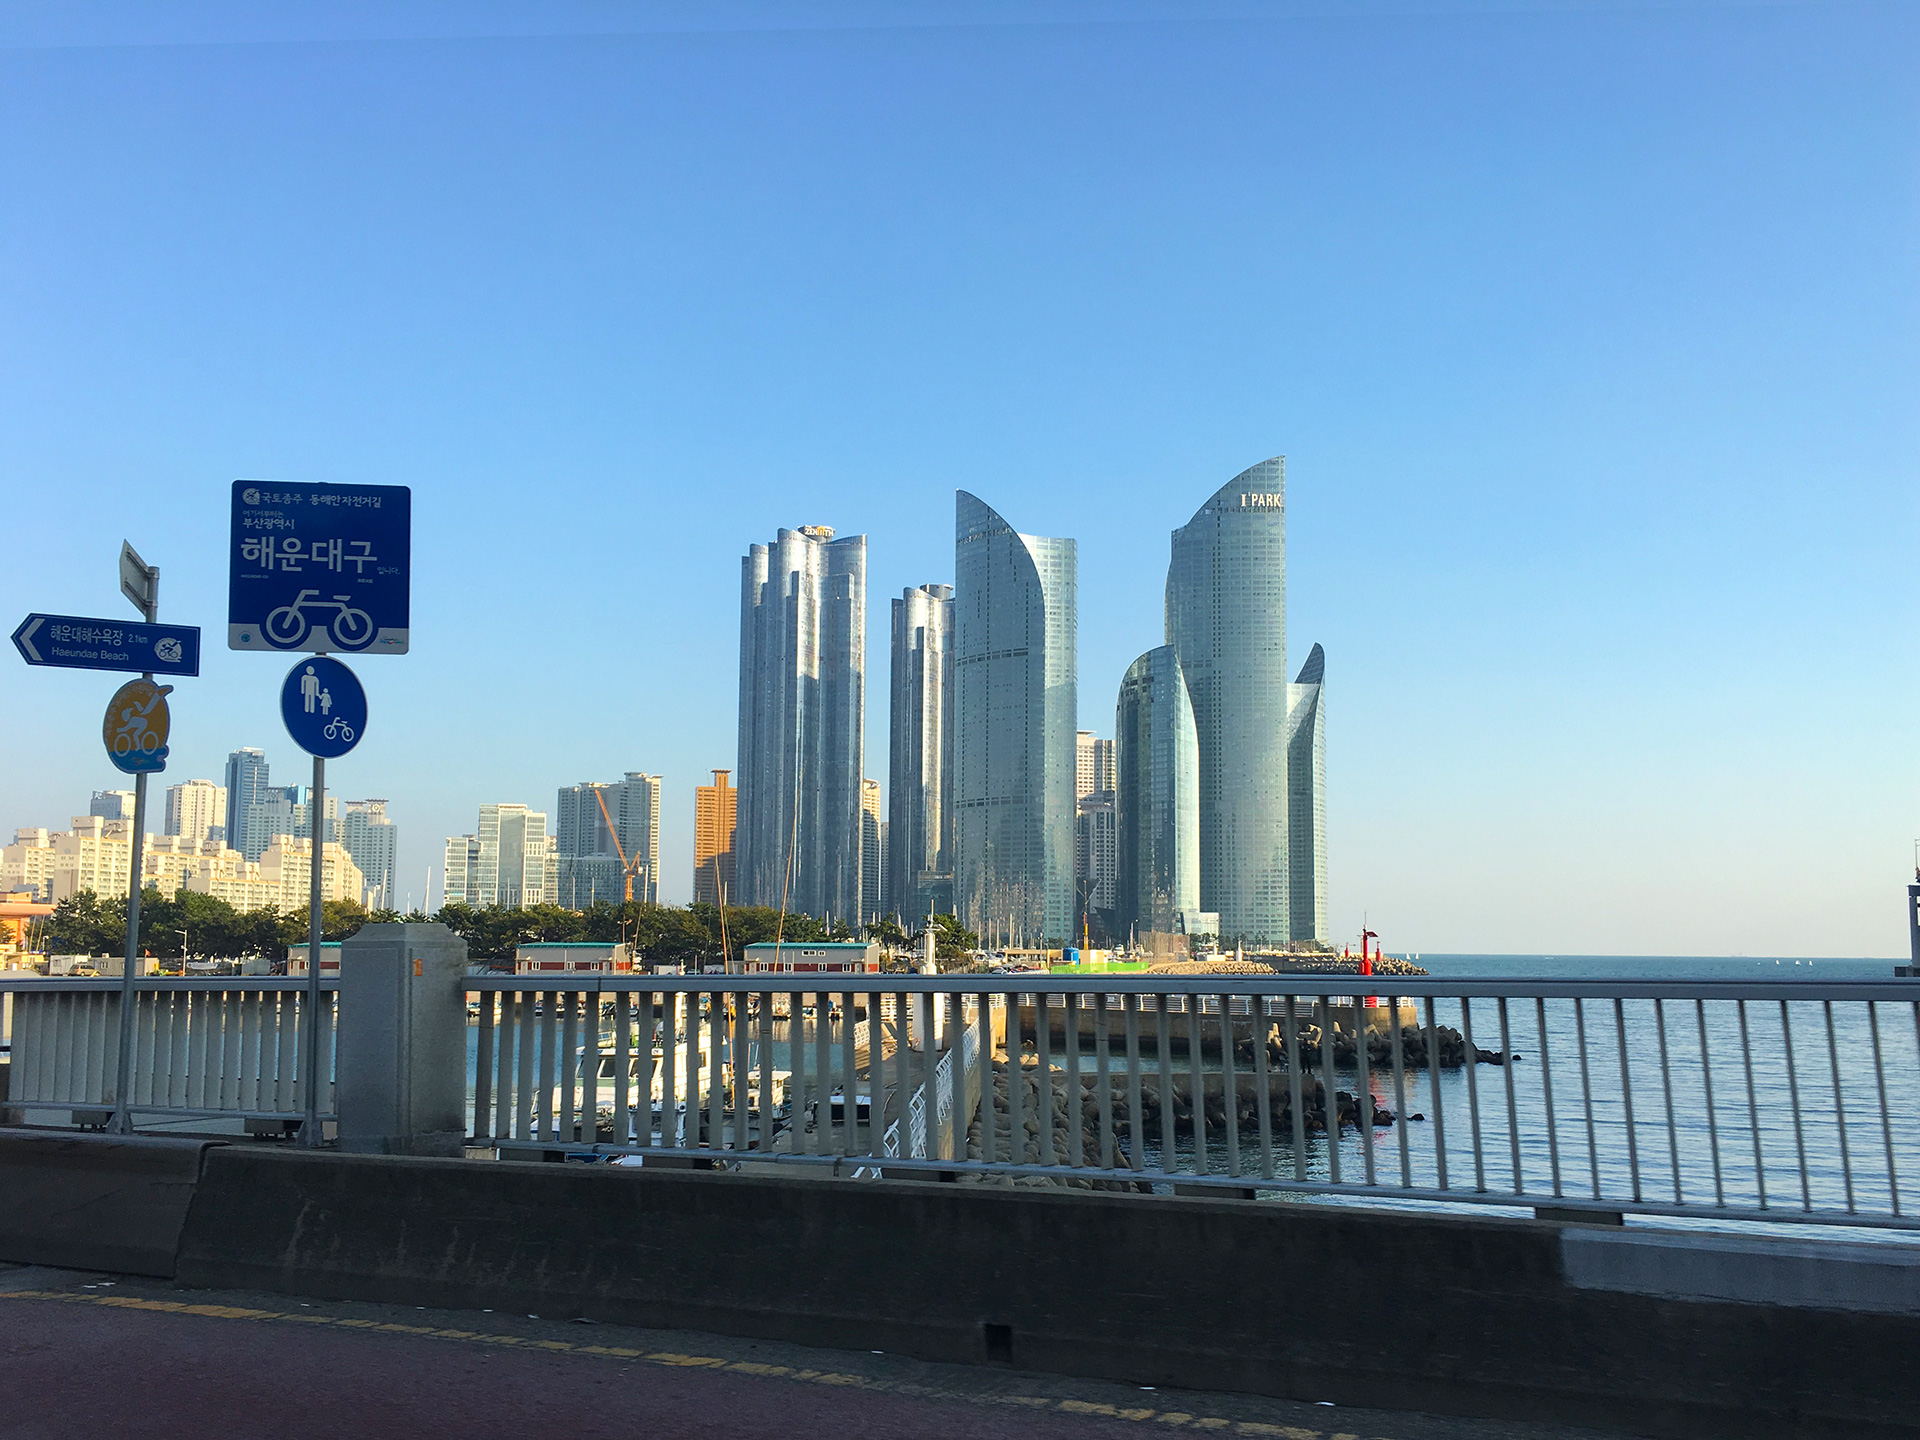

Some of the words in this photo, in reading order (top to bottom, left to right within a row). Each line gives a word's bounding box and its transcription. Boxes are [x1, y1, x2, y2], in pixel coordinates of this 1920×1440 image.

[262, 492, 303, 505] 국토종주
[310, 494, 382, 508] 동해안자전거길
[242, 518, 295, 530] 부산광역시
[240, 536, 378, 573] 해운대구
[50, 625, 124, 646] 해운대해수욕장
[128, 633, 149, 644] 2.1km
[51, 646, 99, 659] Haeundae
[100, 650, 129, 661] Beach
